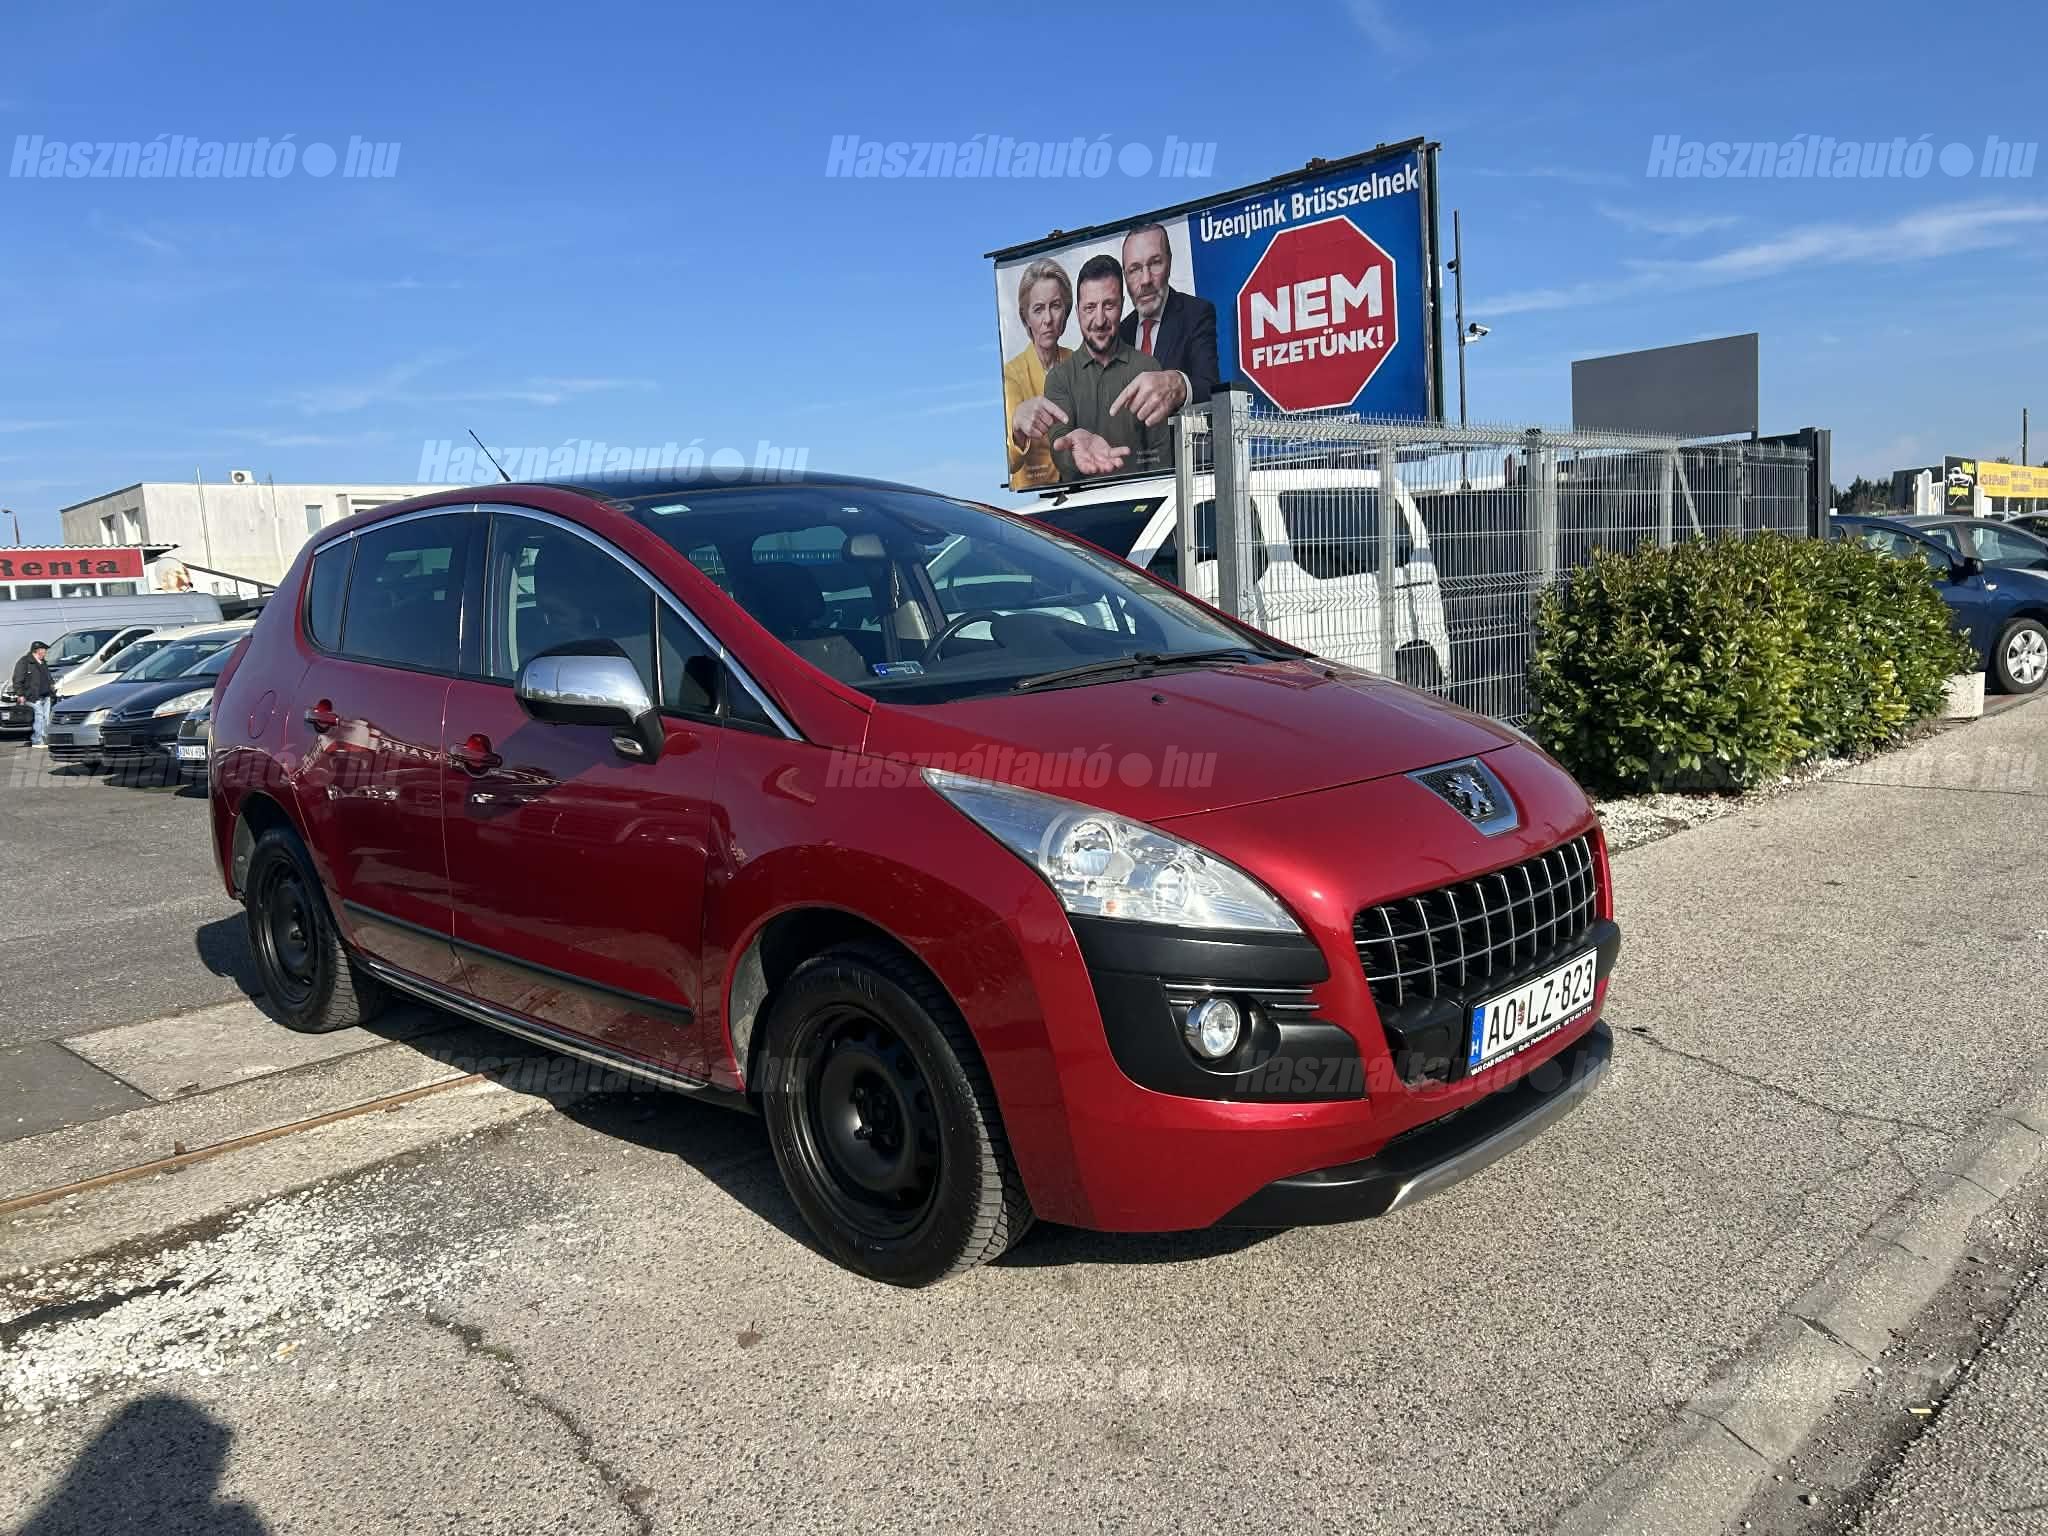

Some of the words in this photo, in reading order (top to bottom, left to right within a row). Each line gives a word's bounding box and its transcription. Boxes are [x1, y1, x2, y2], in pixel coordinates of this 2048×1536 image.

[1200, 199, 1286, 242] Üzenjünk
[1292, 164, 1419, 219] Brüsszelnek
[1251, 265, 1383, 340] NEM
[1252, 326, 1384, 370] FIZETÜNK!
[1471, 1039, 1479, 1056] H
[1487, 998, 1517, 1049] AO
